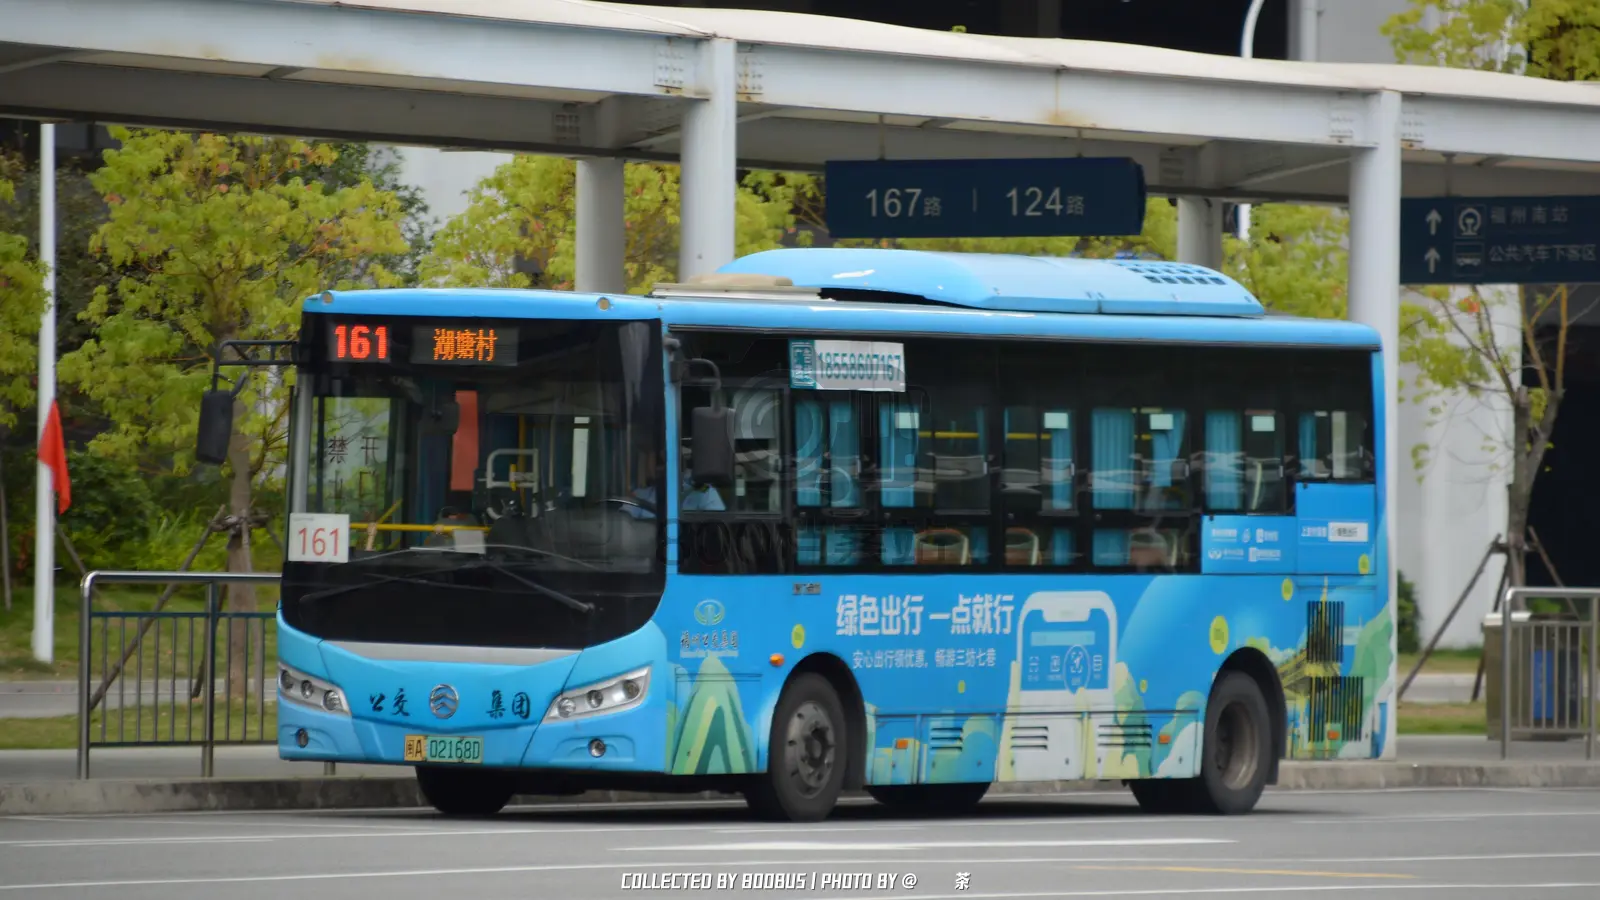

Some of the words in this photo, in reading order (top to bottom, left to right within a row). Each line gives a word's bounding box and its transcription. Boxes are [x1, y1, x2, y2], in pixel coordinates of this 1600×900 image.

[865, 188, 942, 217] 167路
[1006, 187, 1085, 216] 124路
[1490, 205, 1569, 224] 福州南站
[335, 325, 387, 359] 161
[433, 328, 497, 361] 湖塘村
[298, 527, 339, 556] 161
[836, 594, 924, 636] 绿色出行
[929, 593, 1015, 635] 一点就行
